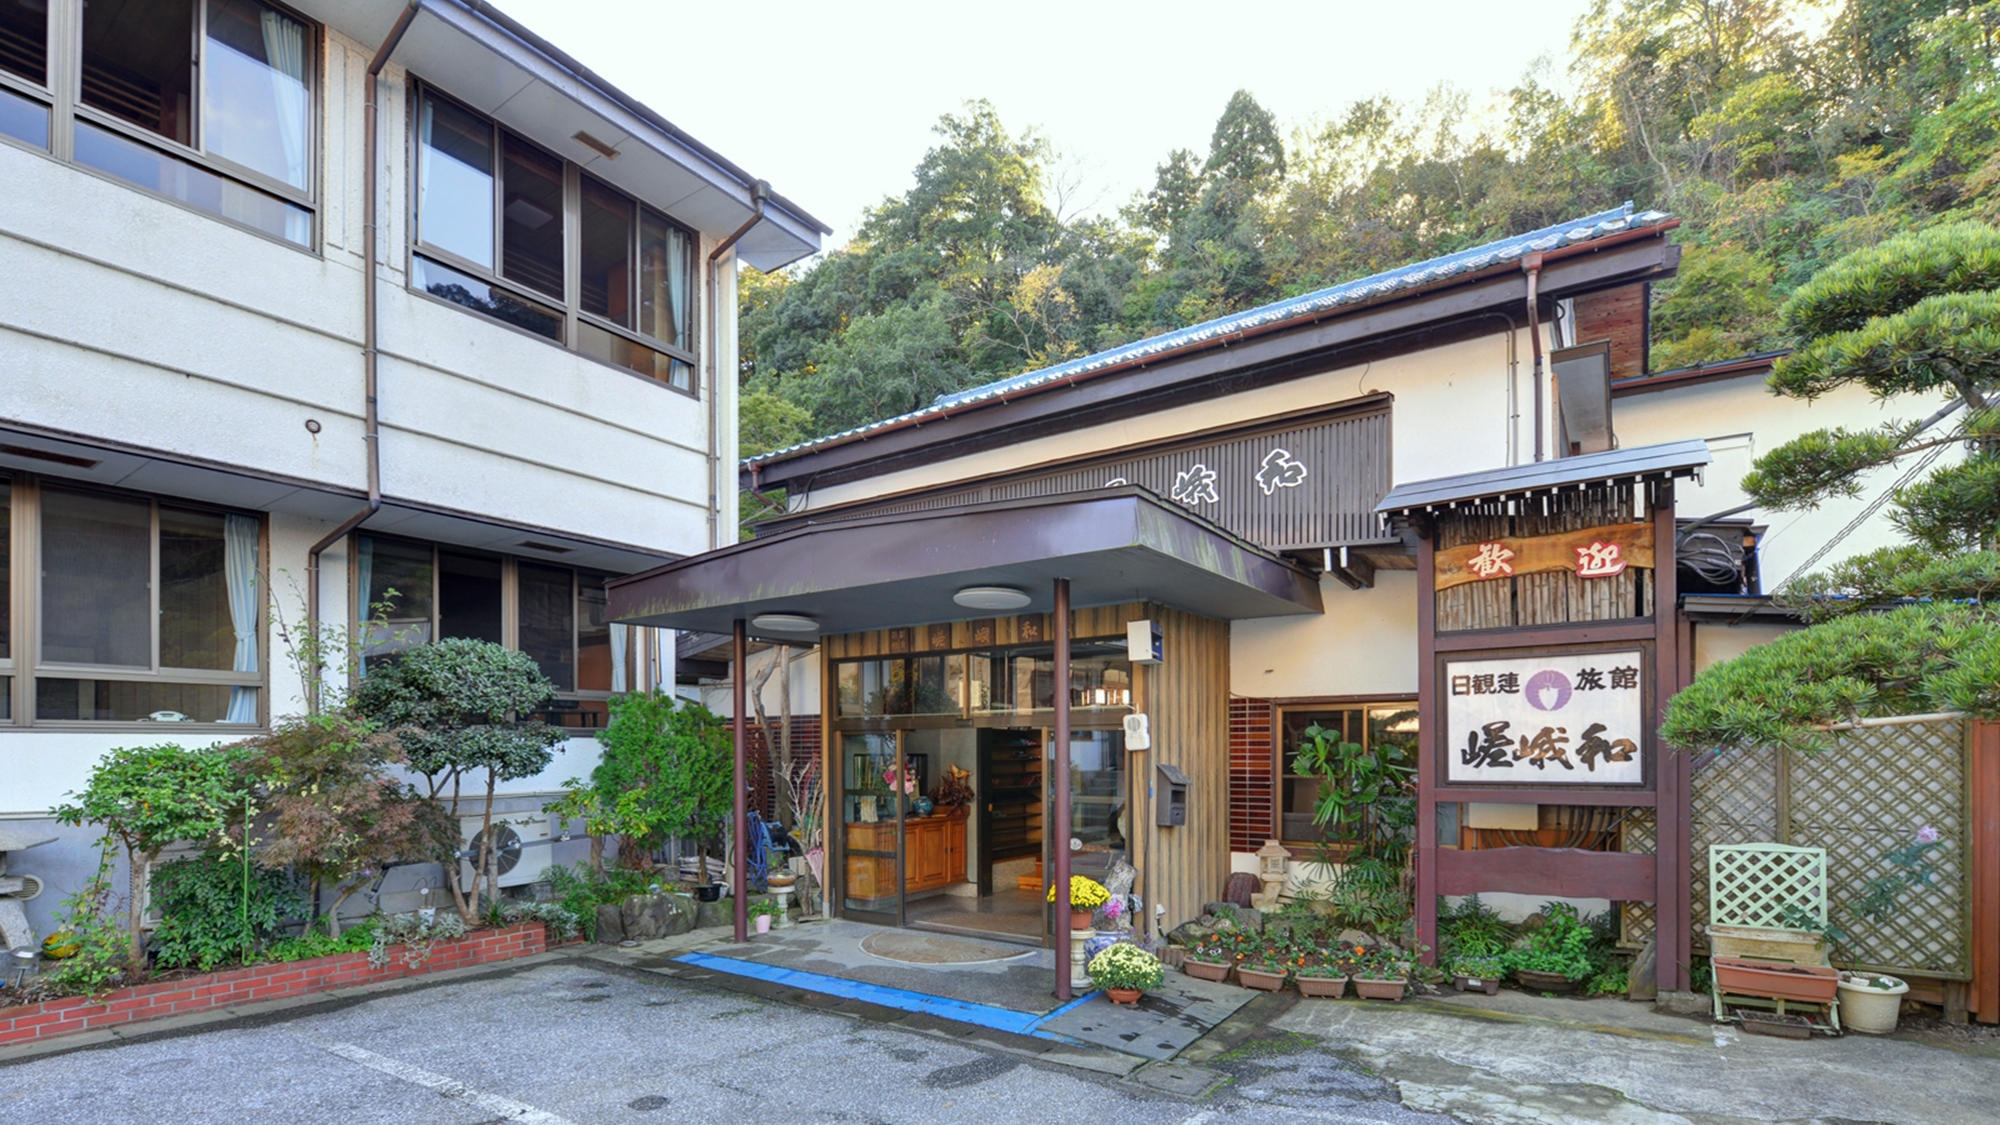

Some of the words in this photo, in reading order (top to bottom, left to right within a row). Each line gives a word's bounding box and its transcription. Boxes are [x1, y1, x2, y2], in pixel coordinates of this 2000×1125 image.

[1105, 448, 1307, 505] 峨和
[1468, 540, 1627, 578] 歓迎
[1452, 672, 1520, 696] 日観連
[1574, 665, 1639, 691] 旅館
[1461, 721, 1637, 771] 嵯峨和
